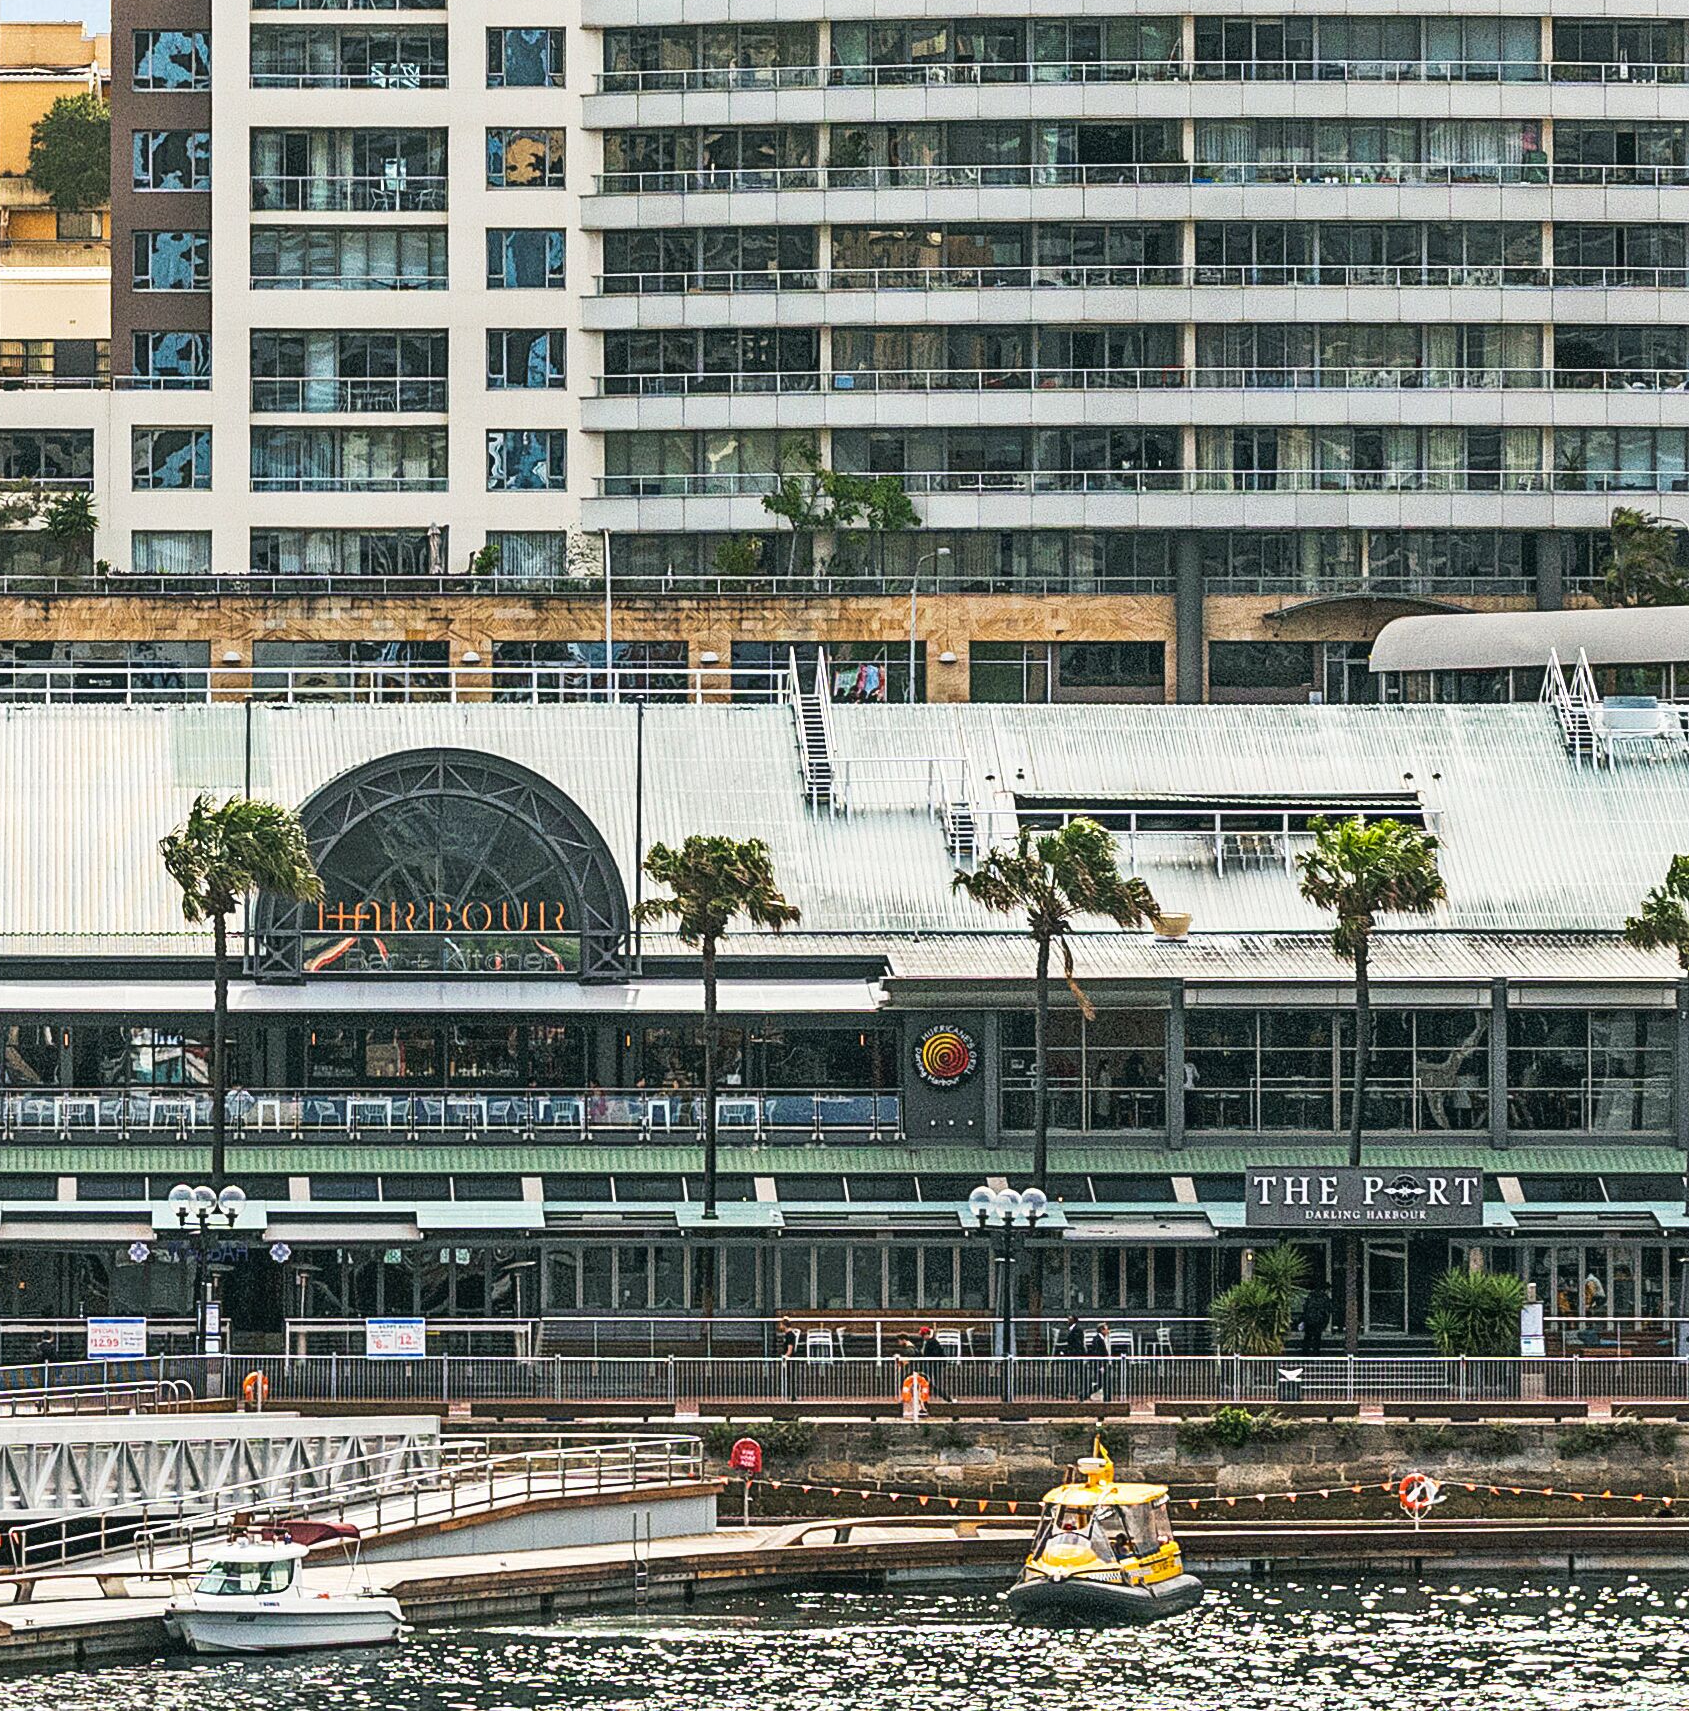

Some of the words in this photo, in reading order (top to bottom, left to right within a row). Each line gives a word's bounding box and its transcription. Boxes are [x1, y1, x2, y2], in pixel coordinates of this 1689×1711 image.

[318, 901, 566, 931] HARBOUR
[1253, 1176, 1339, 1205] THE
[1305, 1210, 1361, 1220] DARLING
[1367, 1210, 1426, 1220] HARBOUR
